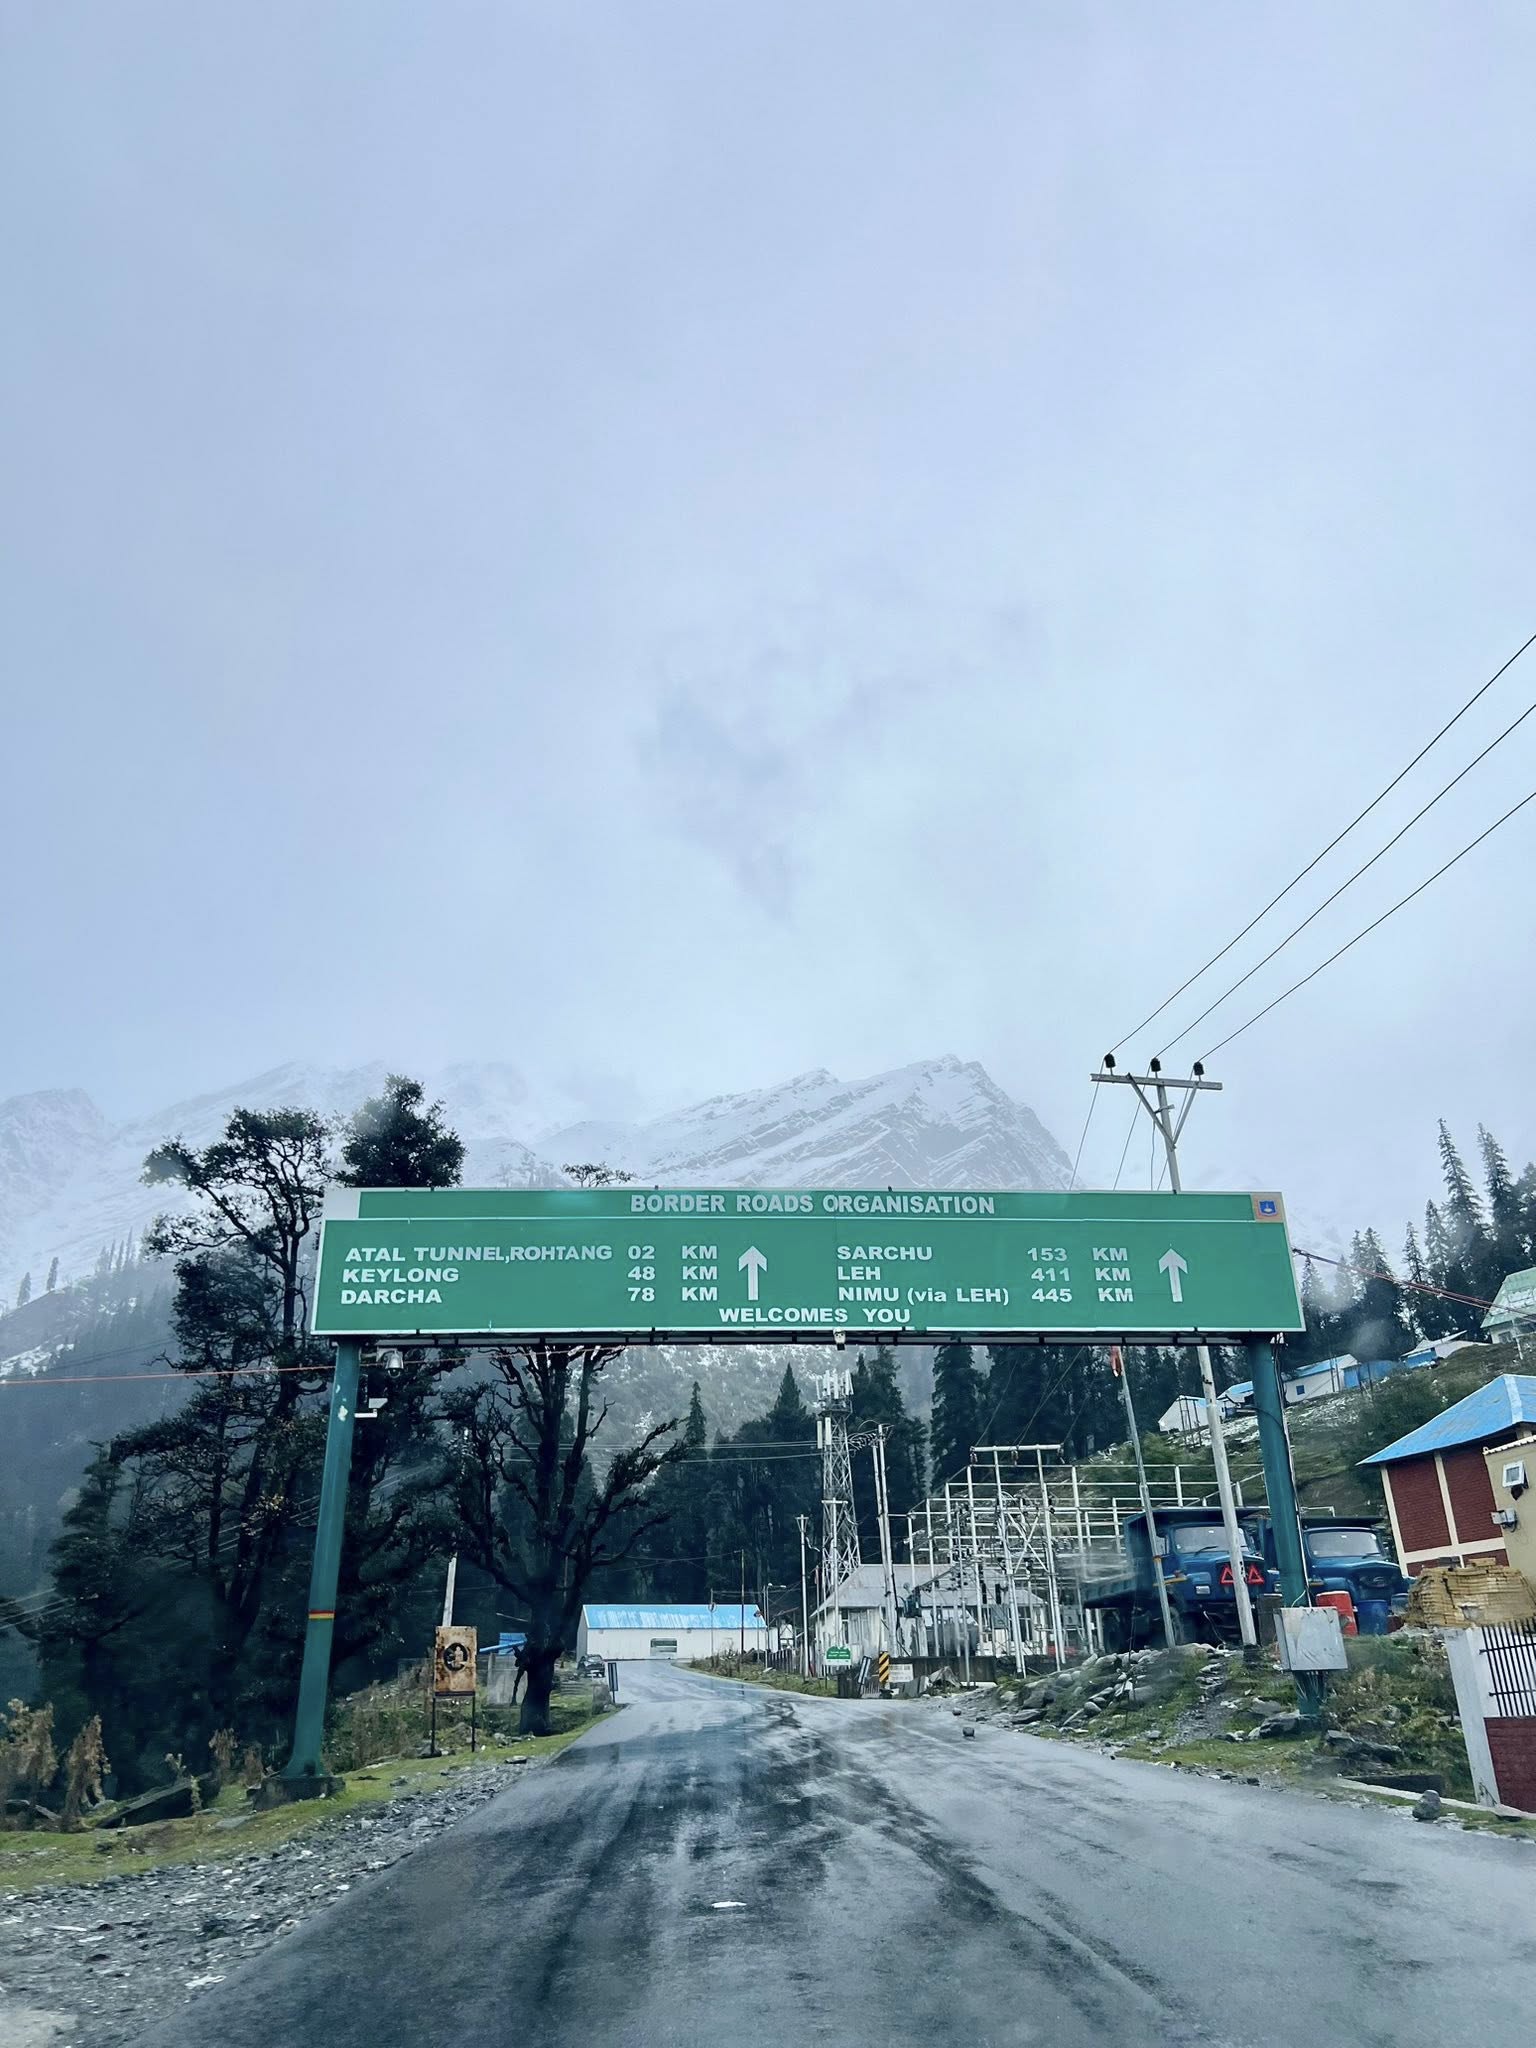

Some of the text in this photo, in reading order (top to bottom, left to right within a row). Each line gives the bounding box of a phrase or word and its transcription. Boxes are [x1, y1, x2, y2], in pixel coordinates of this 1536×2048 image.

[631, 1195, 995, 1214] BORDER ROADS ORGANISATION
[345, 1246, 717, 1263] ATAL TUNNEL,ROHTANG 02 KM
[837, 1246, 1128, 1262] SARCHU 153 KM
[342, 1266, 717, 1283] KEYLONG 48 KM
[838, 1267, 1131, 1282] LEH 411 KM
[341, 1287, 717, 1304] DARCHA 78 KM
[838, 1287, 1134, 1305] NIMU (via LEH) 445 KM
[719, 1308, 910, 1323] WELCOMES YOU
